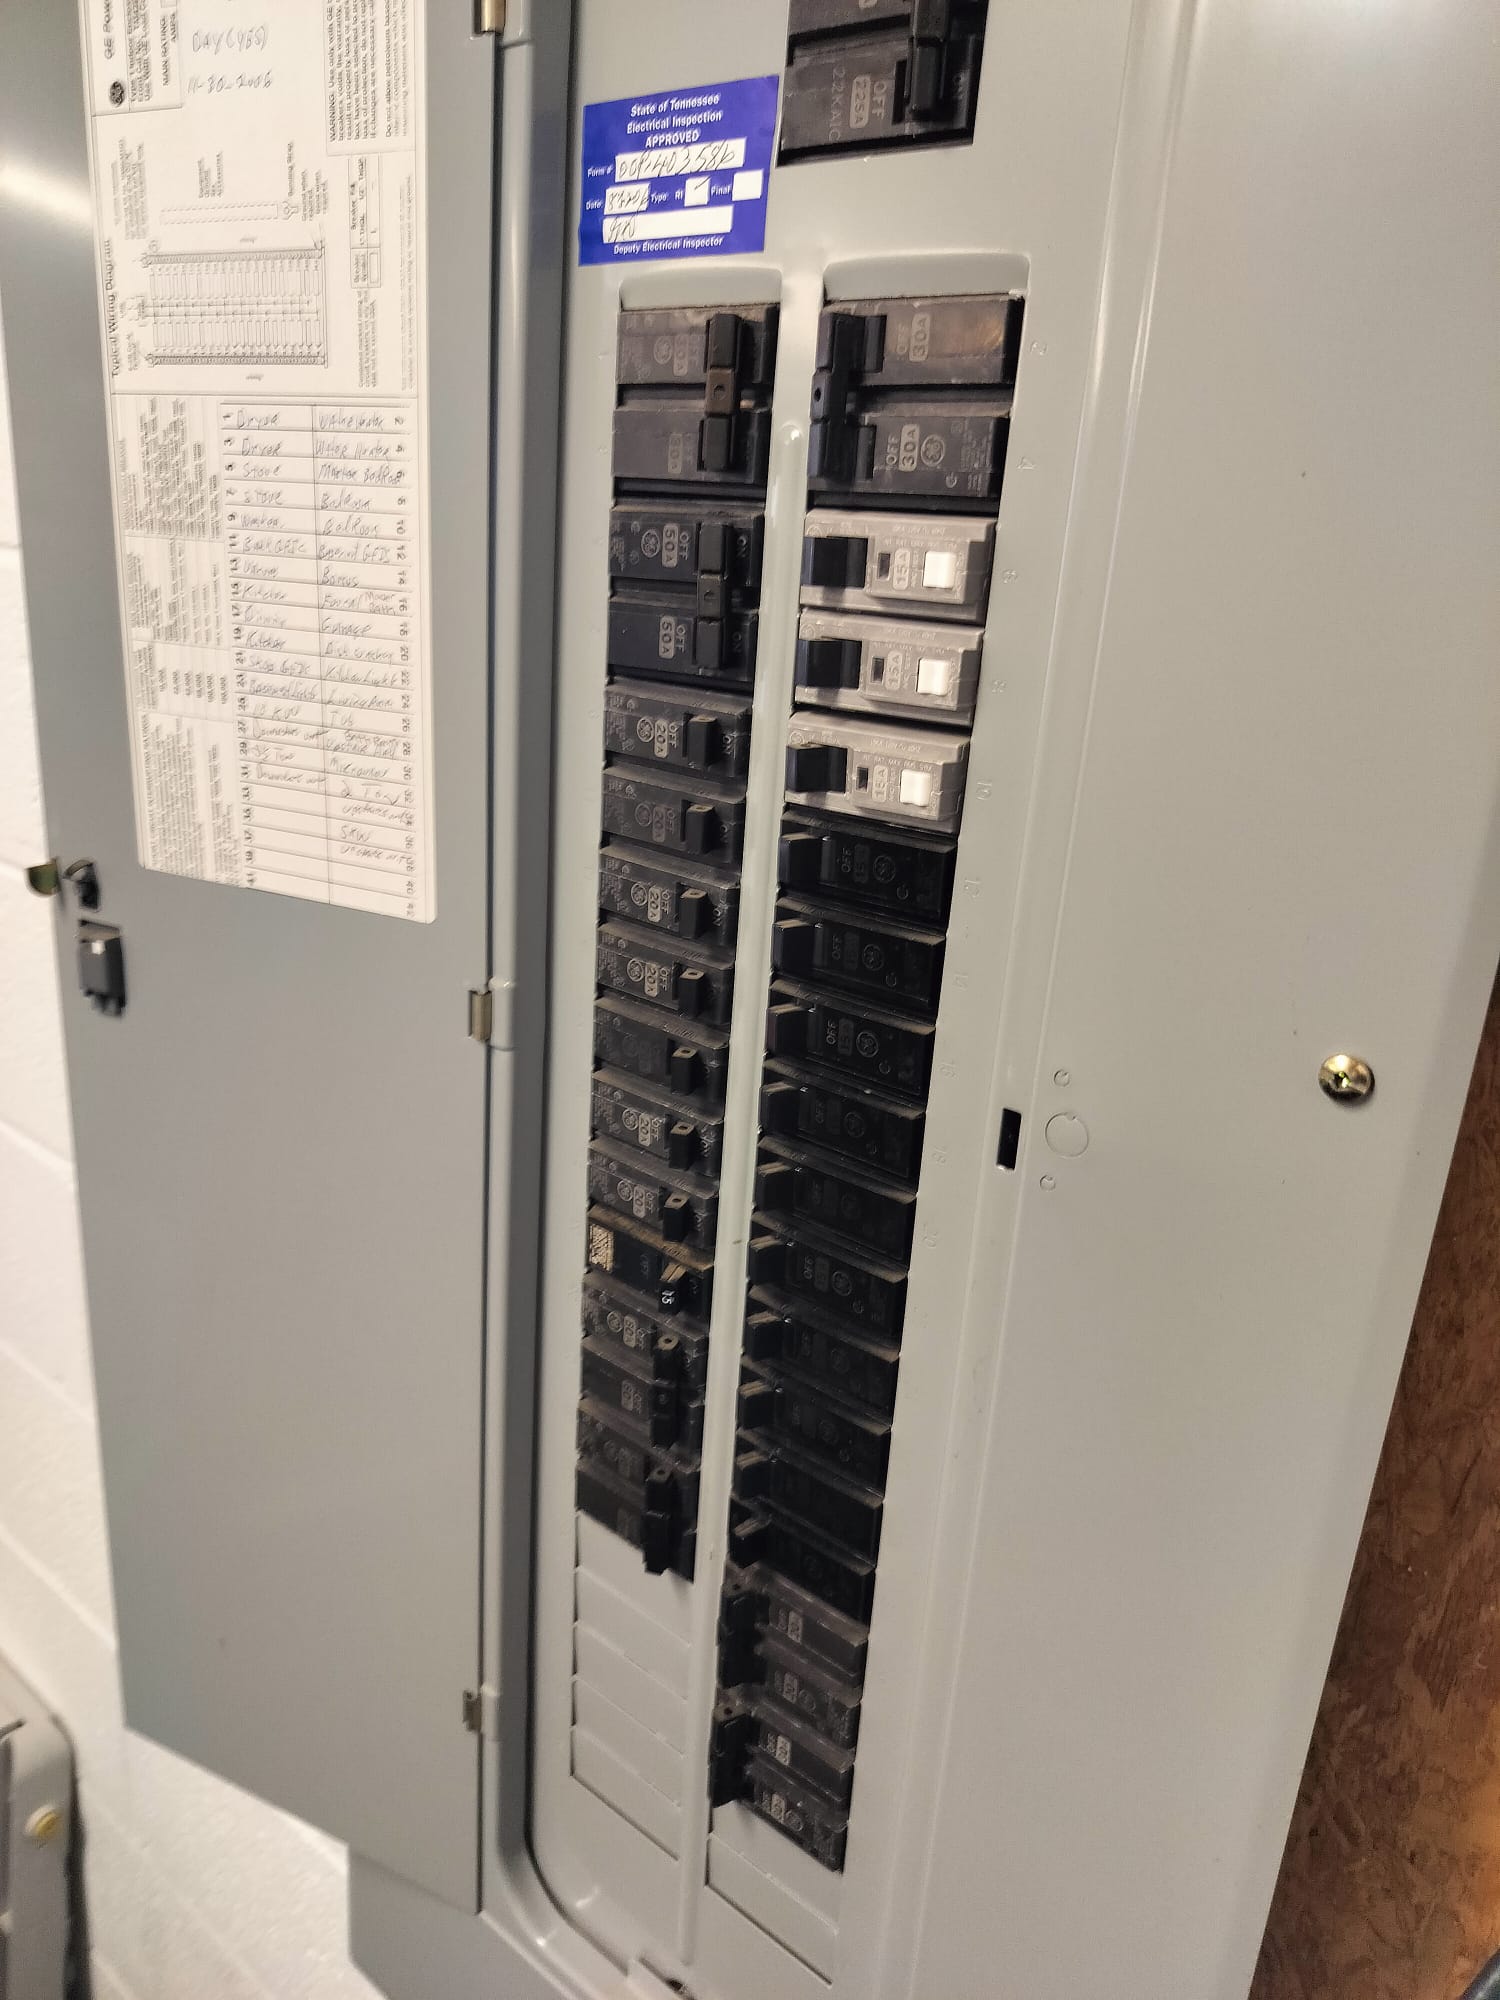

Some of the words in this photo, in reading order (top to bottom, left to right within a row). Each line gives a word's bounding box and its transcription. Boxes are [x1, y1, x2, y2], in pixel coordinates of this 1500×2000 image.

[631, 102, 655, 117] State
[658, 101, 668, 113] of
[670, 93, 720, 110] Tennessee
[872, 80, 887, 120] OFF
[627, 119, 669, 134] Electrical
[672, 111, 722, 129] Inspection
[645, 129, 700, 148] APPROVED
[642, 239, 680, 252] Electrical
[682, 235, 723, 250] Inspector
[106, 294, 118, 334] Wiring
[885, 435, 898, 466] OFF
[902, 425, 919, 469] 30A
[664, 527, 678, 564] 50A
[679, 531, 690, 560] OFF
[661, 620, 674, 654] 50A
[676, 624, 687, 653] OFF
[655, 723, 668, 755] 20A
[668, 721, 679, 749] OFF
[649, 890, 661, 919] 20A
[639, 1115, 651, 1144] 20A
[661, 1289, 675, 1305] 15
